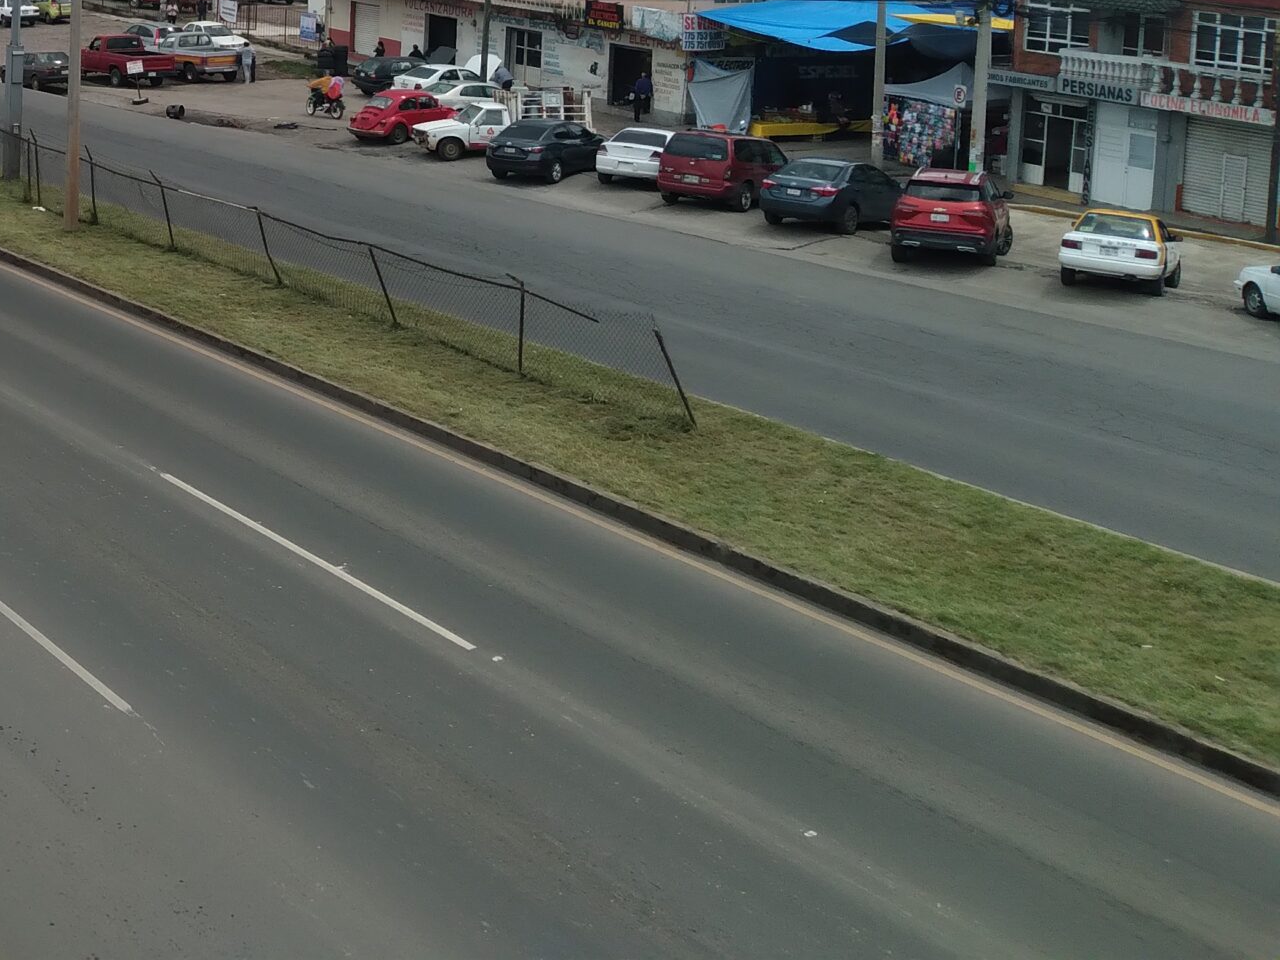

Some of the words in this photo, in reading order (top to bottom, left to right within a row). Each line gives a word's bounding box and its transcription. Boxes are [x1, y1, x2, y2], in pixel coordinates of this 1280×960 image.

[404, 0, 473, 18] VULCANIZADORA
[684, 15, 696, 31] SE
[684, 32, 696, 40] 775
[684, 41, 696, 49] 775
[987, 73, 1004, 83] OMOS
[1005, 75, 1048, 88] FABRICANTES
[1062, 78, 1133, 102] PERSIANAS
[1142, 92, 1186, 110] COCINA
[1190, 99, 1260, 122] ECONOMICA
